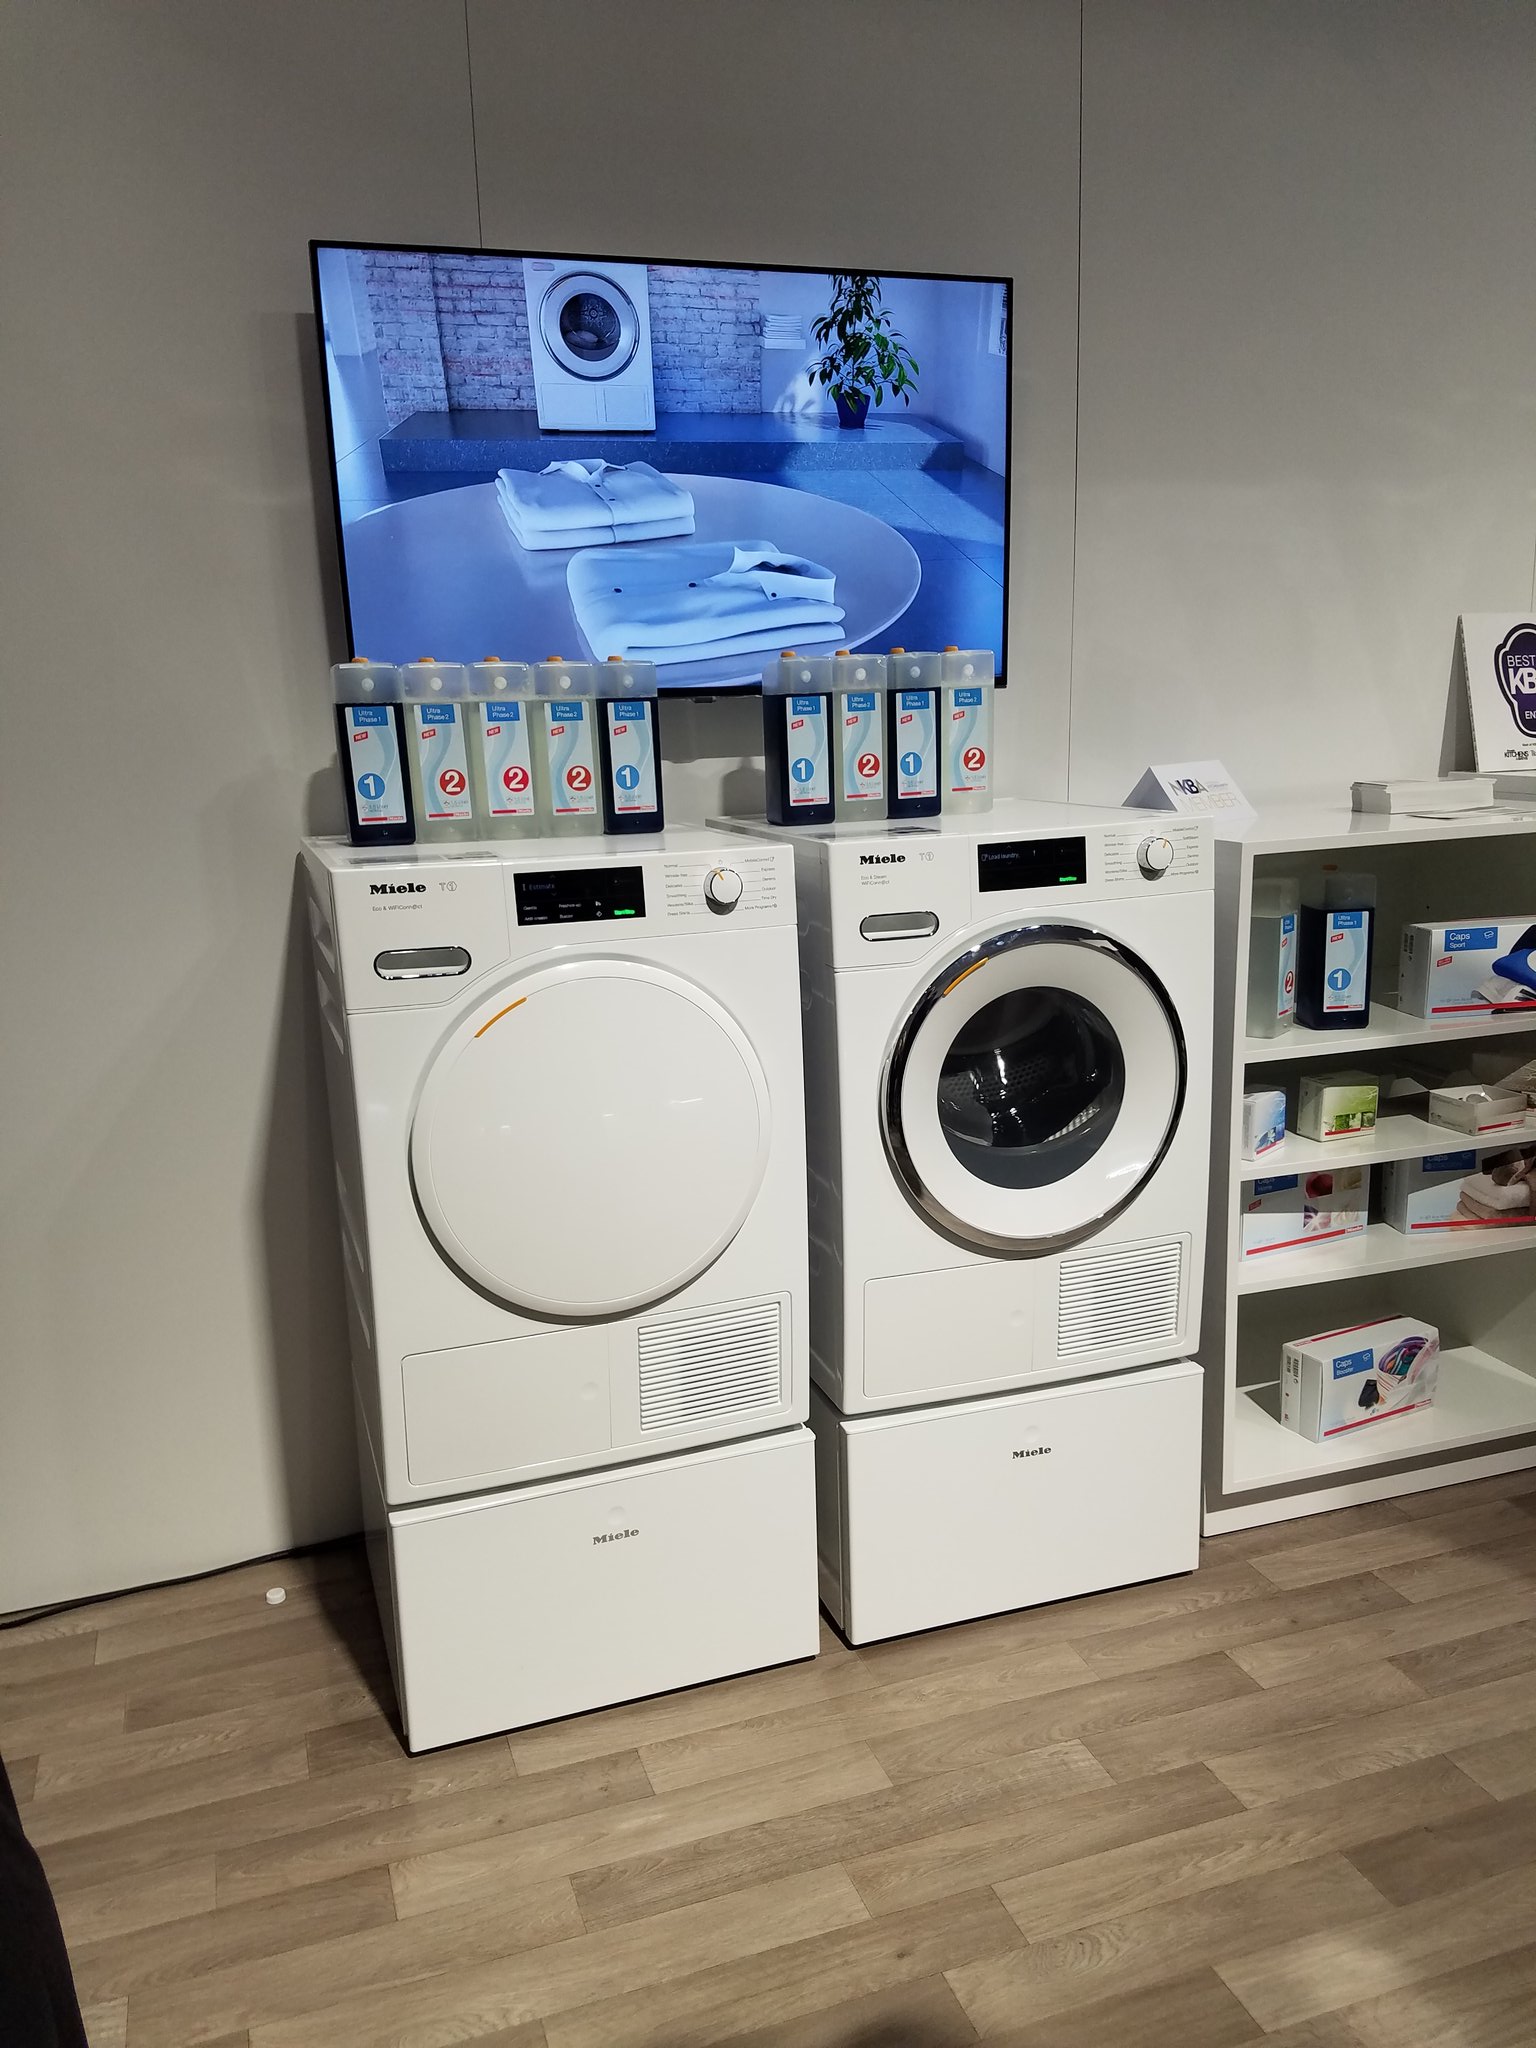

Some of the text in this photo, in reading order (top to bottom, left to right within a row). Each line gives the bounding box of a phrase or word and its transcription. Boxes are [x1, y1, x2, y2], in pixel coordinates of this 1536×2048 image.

[1507, 655, 1536, 667] BEST
[862, 755, 876, 775] 2
[905, 754, 914, 773] 1
[968, 749, 981, 769] 2
[508, 768, 524, 789] 2
[571, 767, 587, 788] 2
[621, 767, 631, 787] 1
[797, 760, 806, 780] 1
[364, 776, 376, 796] 1
[445, 771, 461, 792] 2
[1168, 779, 1209, 796] NKBA
[860, 854, 906, 865] Miele
[369, 882, 427, 895] Miele
[1449, 932, 1471, 942] Caps
[1286, 972, 1292, 992] 2
[1334, 970, 1343, 989] 1
[1335, 1359, 1353, 1369] Caps
[1012, 1447, 1052, 1459] Miele
[592, 1529, 640, 1545] Miele
